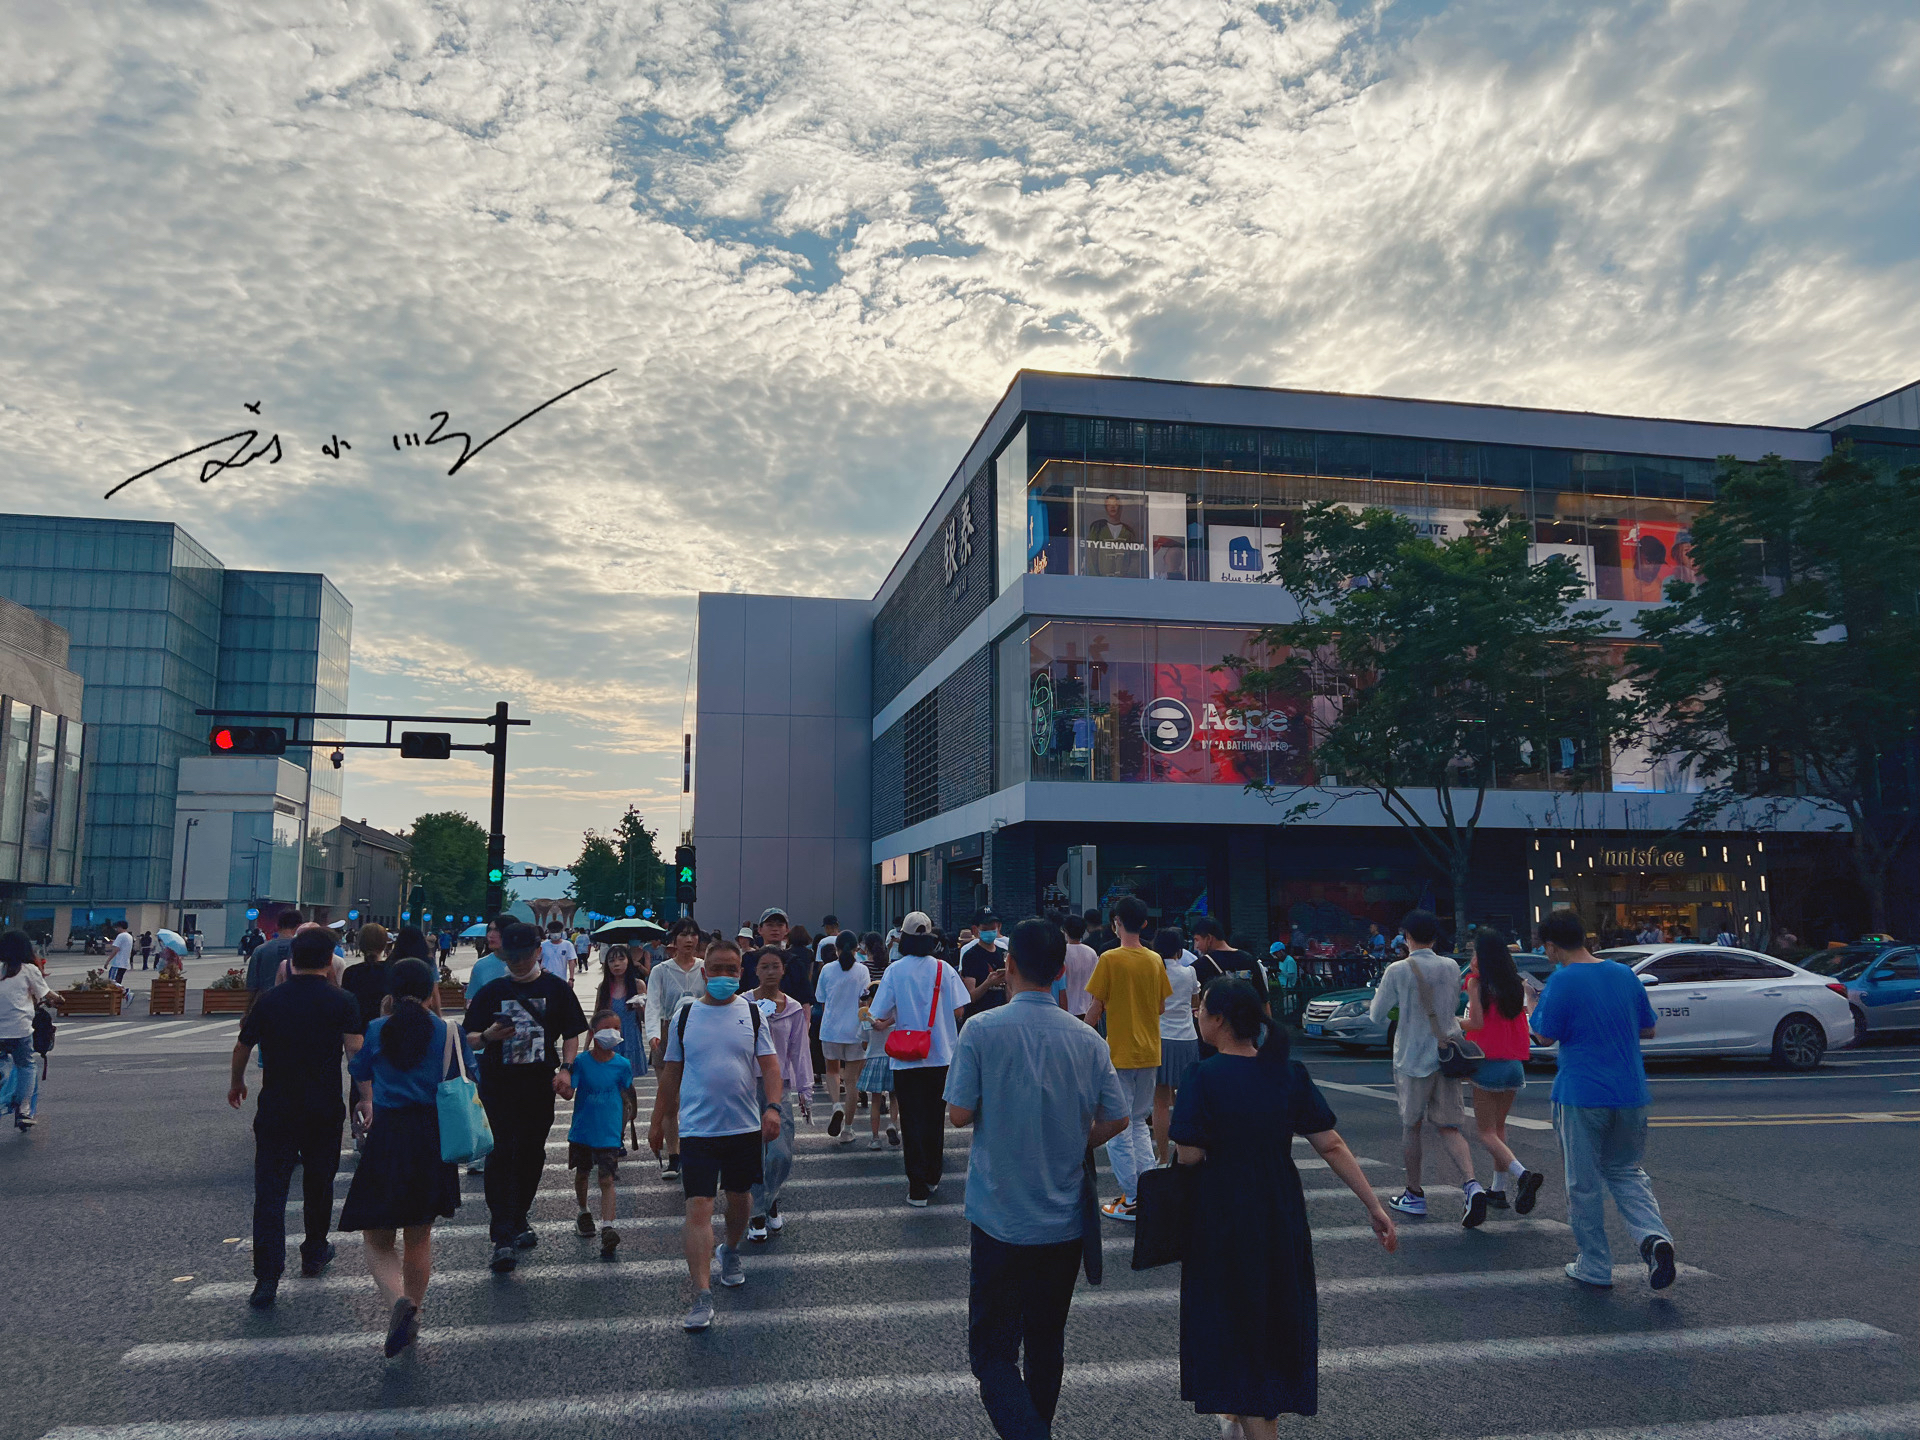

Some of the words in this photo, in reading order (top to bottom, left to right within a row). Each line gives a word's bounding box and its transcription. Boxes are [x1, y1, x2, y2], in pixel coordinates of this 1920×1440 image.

[1079, 540, 1148, 552] STYLENANDA
[1233, 550, 1248, 566] i.t
[1221, 572, 1243, 582] blue
[1199, 703, 1288, 738] Aape
[1202, 740, 1212, 750] BY
[1227, 740, 1262, 751] BATHING
[1600, 845, 1685, 867] innisfree
[1657, 1007, 1690, 1017] T3出行
